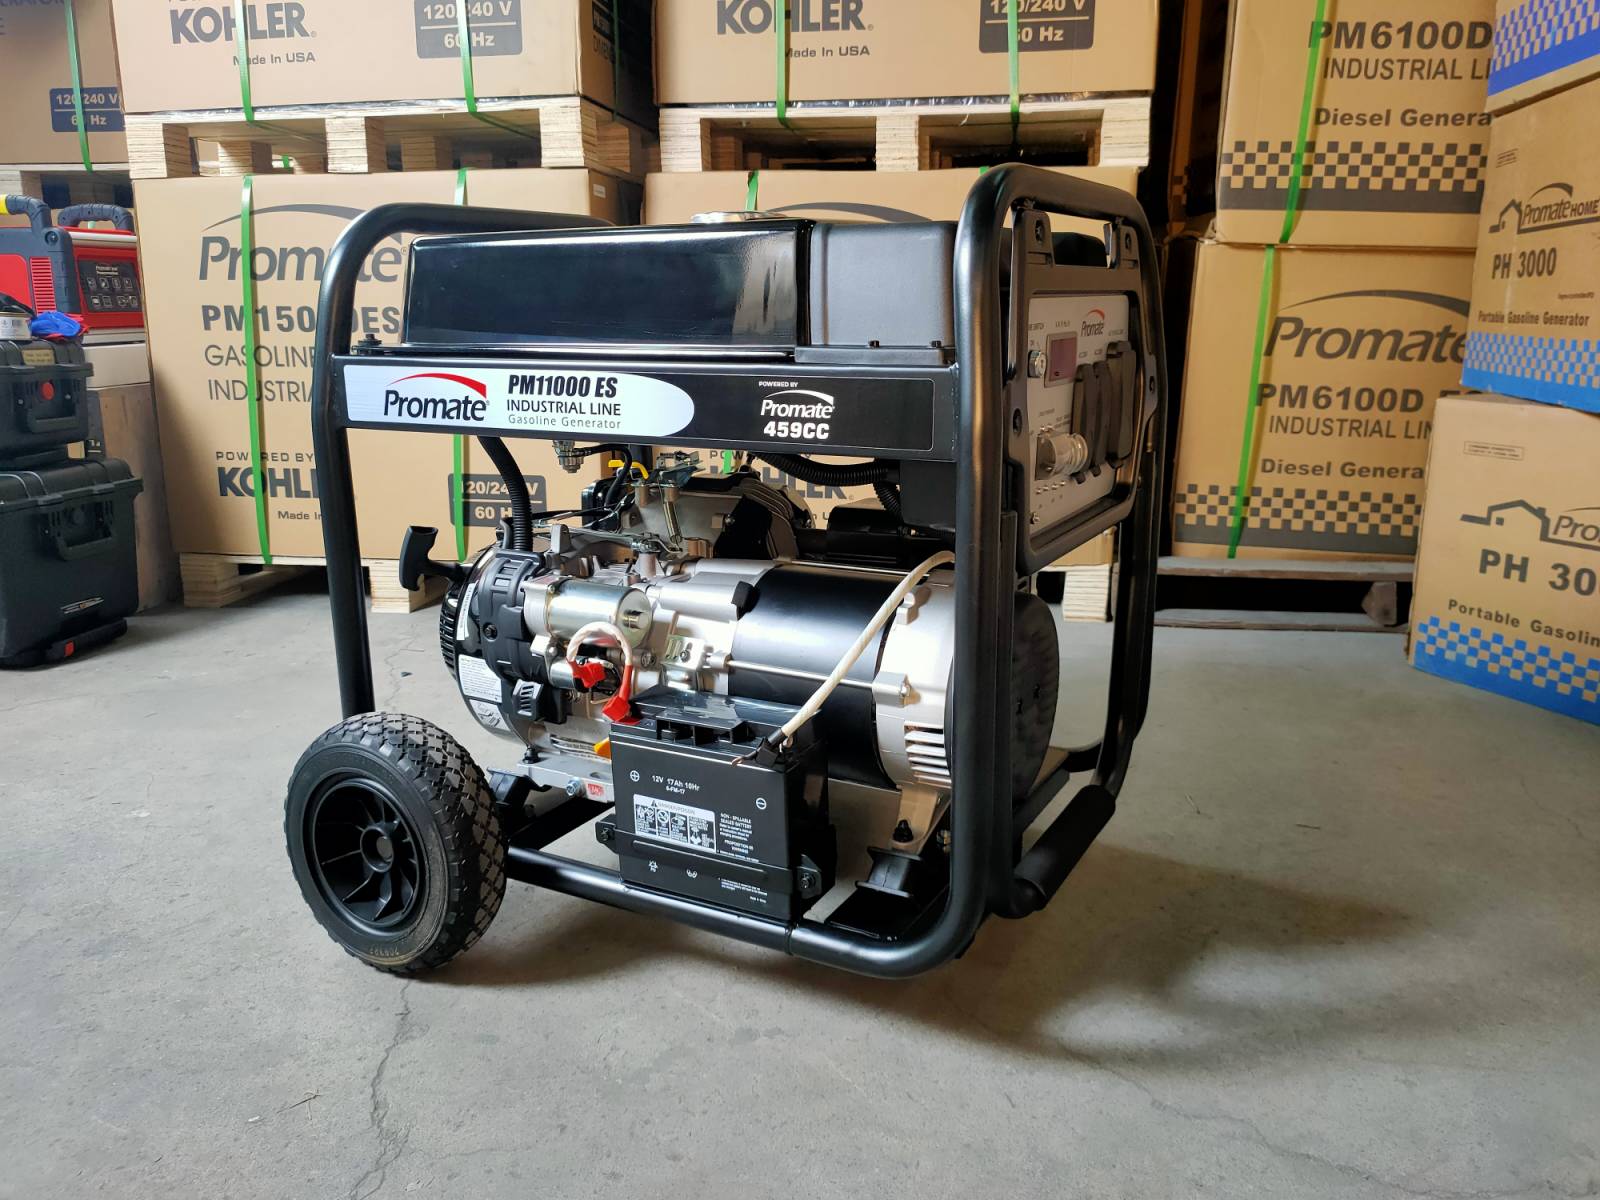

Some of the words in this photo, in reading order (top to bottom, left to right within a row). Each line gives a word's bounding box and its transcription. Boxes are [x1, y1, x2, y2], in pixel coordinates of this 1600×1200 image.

[499, 0, 512, 16] V
[1074, 0, 1085, 10] V
[472, 32, 495, 47] Hz
[1040, 26, 1064, 42] Hz
[1308, 21, 1493, 50] PM6100D
[271, 54, 281, 64] In
[286, 52, 316, 63] USA
[822, 47, 833, 57] In
[839, 45, 870, 57] USA
[1323, 57, 1463, 80] INDUSTRIAL
[90, 115, 107, 125] Hz
[1314, 107, 1391, 127] Diesel
[1492, 253, 1512, 279] PH
[1517, 248, 1557, 278] 3000
[1542, 311, 1590, 326] Generator
[508, 374, 593, 398] PM11000
[594, 376, 618, 399] ES
[384, 389, 487, 422] Promate
[1256, 383, 1424, 412] PM6100D
[506, 398, 586, 415] INDUSTRIAL
[590, 402, 621, 416] LINE
[760, 399, 834, 419] Promate
[508, 414, 556, 427] Gasoline
[561, 416, 621, 429] Generator
[763, 421, 830, 440] 459CC
[1269, 416, 1397, 439] INDUSTRIAL
[215, 451, 290, 462] POWRED
[295, 452, 314, 463] BY
[1261, 458, 1332, 477] Diesel
[278, 511, 310, 520] Made
[474, 506, 495, 520] 60
[1479, 549, 1529, 583] PH
[1448, 599, 1520, 628] Portable
[652, 775, 664, 783] 12V
